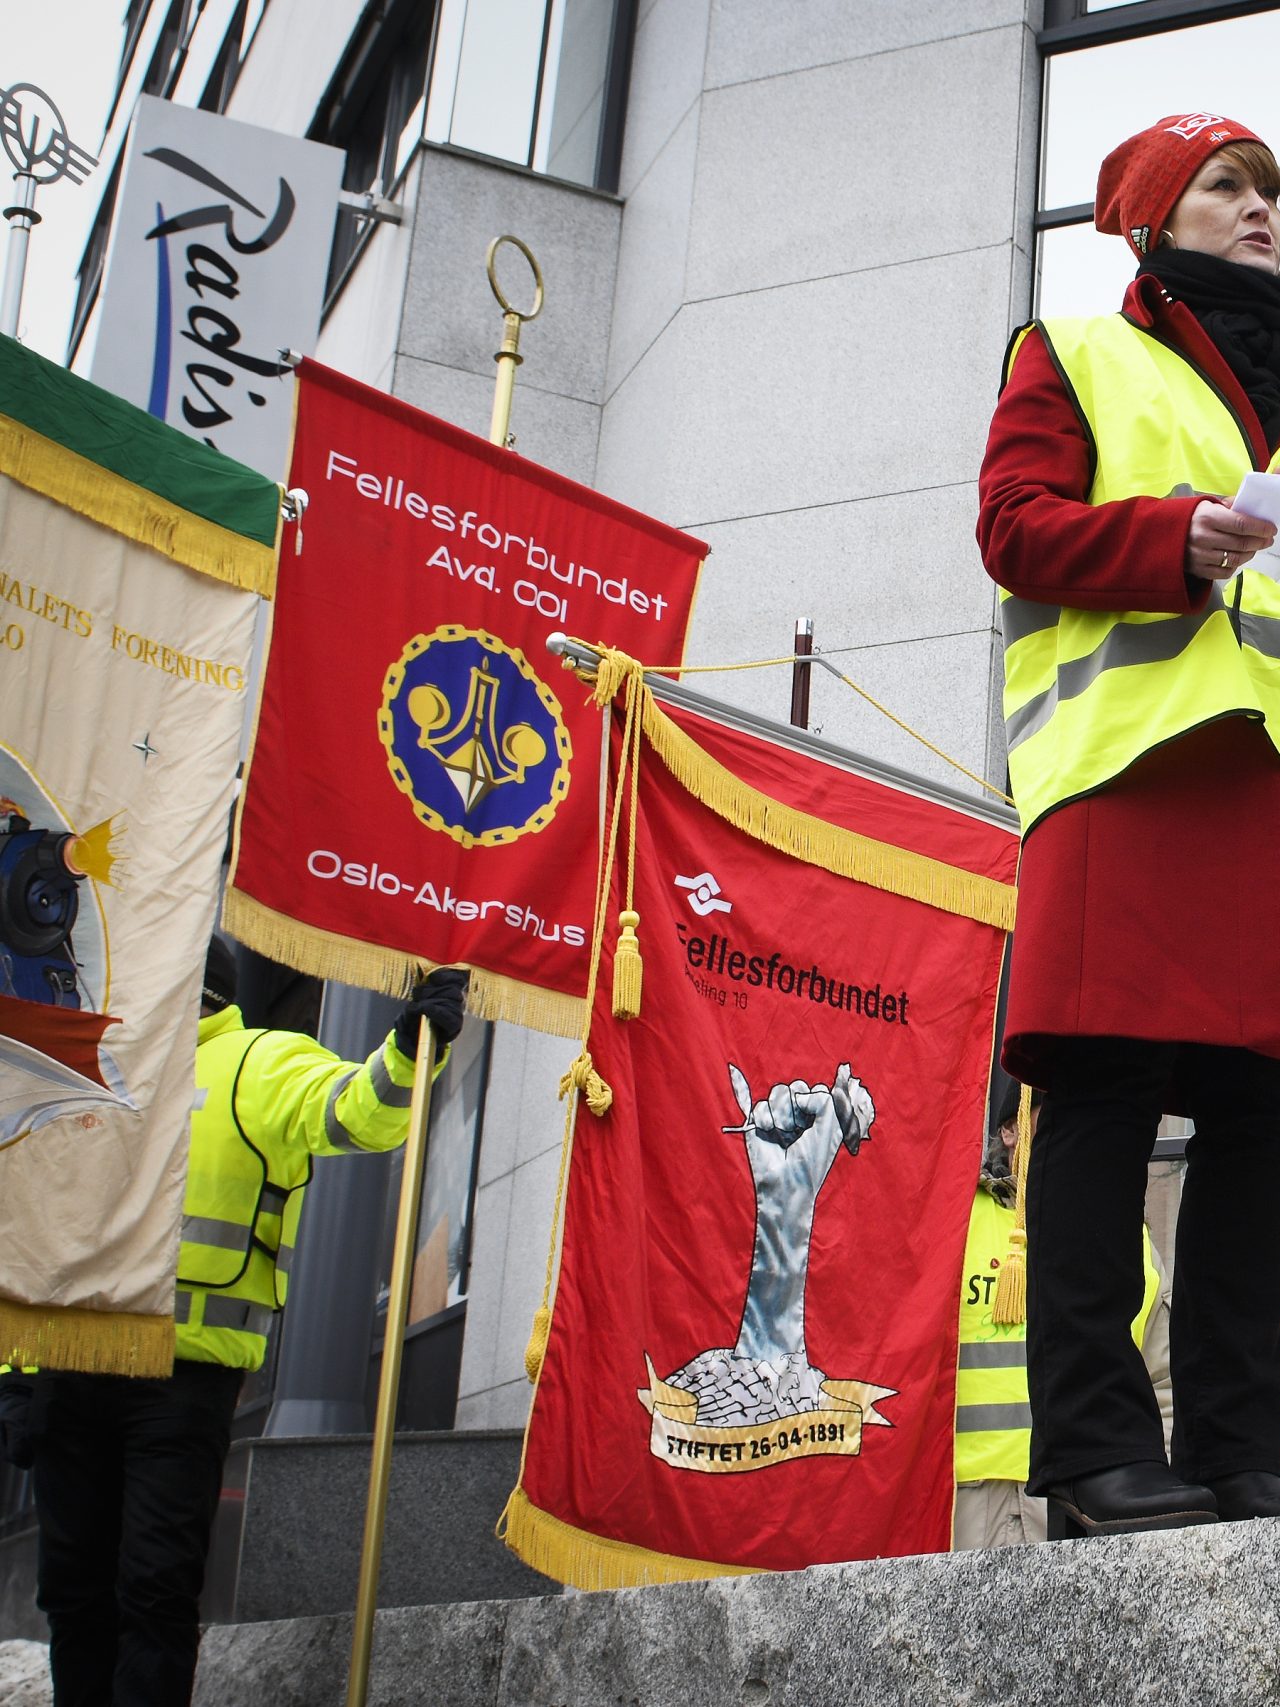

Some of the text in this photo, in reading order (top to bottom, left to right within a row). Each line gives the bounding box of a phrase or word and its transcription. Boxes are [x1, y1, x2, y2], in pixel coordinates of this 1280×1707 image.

[141, 148, 297, 450] Radis
[326, 450, 668, 621] Fellesforbundet
[426, 545, 568, 623] Avd. 001
[111, 624, 245, 691] FORENING
[307, 850, 586, 947] Oslo-Akershus
[666, 1423, 845, 1462] STIFTET 26-04-1891
